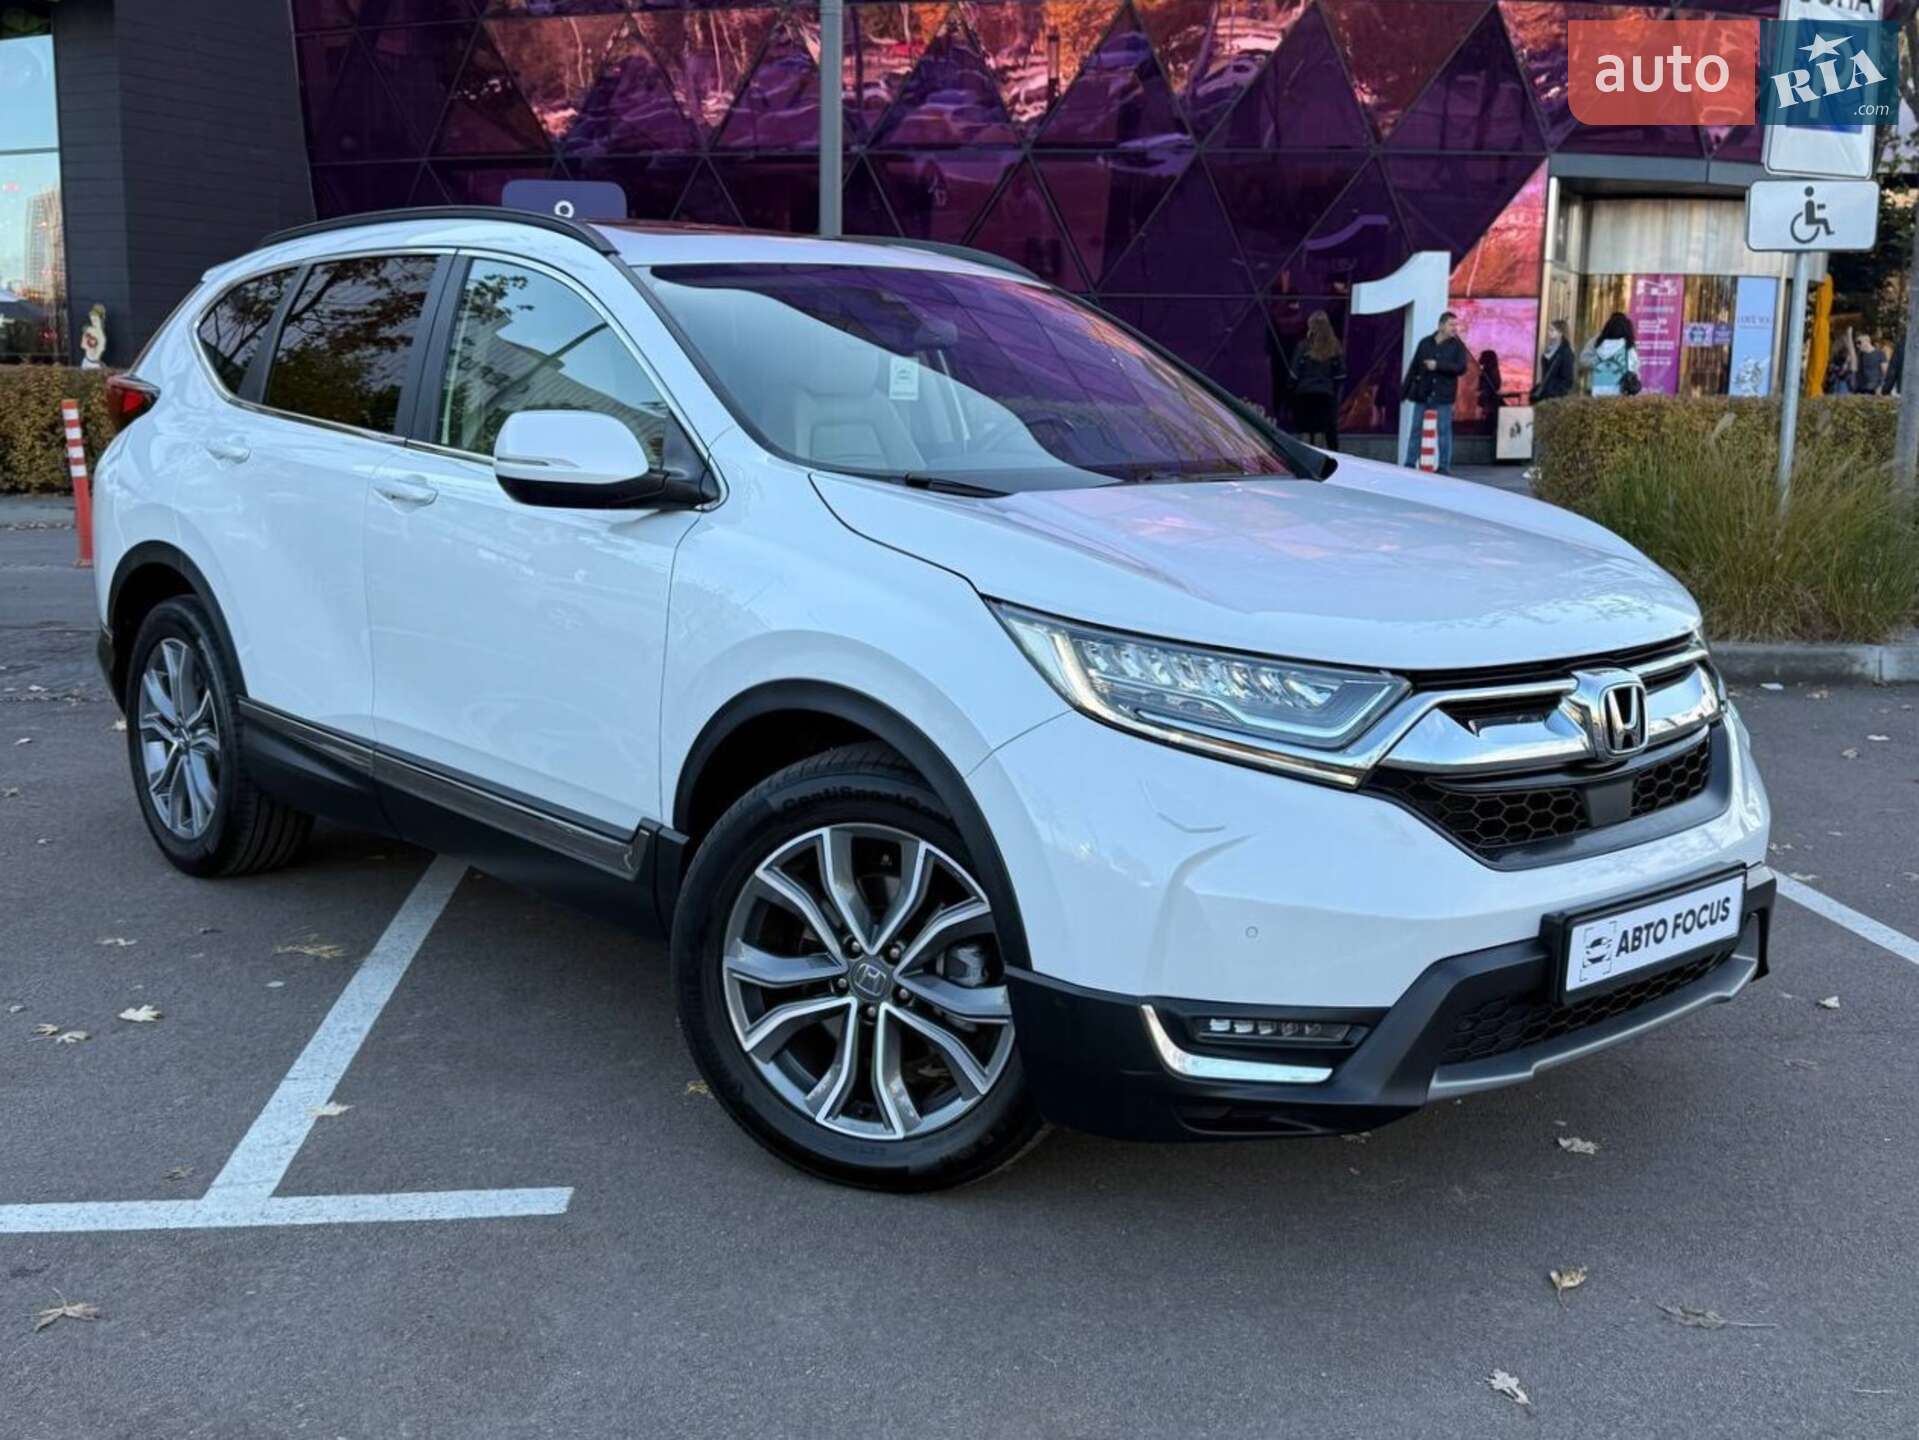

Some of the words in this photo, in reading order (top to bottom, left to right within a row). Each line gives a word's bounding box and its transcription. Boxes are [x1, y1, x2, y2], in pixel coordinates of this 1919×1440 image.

[1351, 251, 1450, 467] 1
[1616, 918, 1668, 958] АВТО
[1672, 896, 1731, 939] FOCUS
